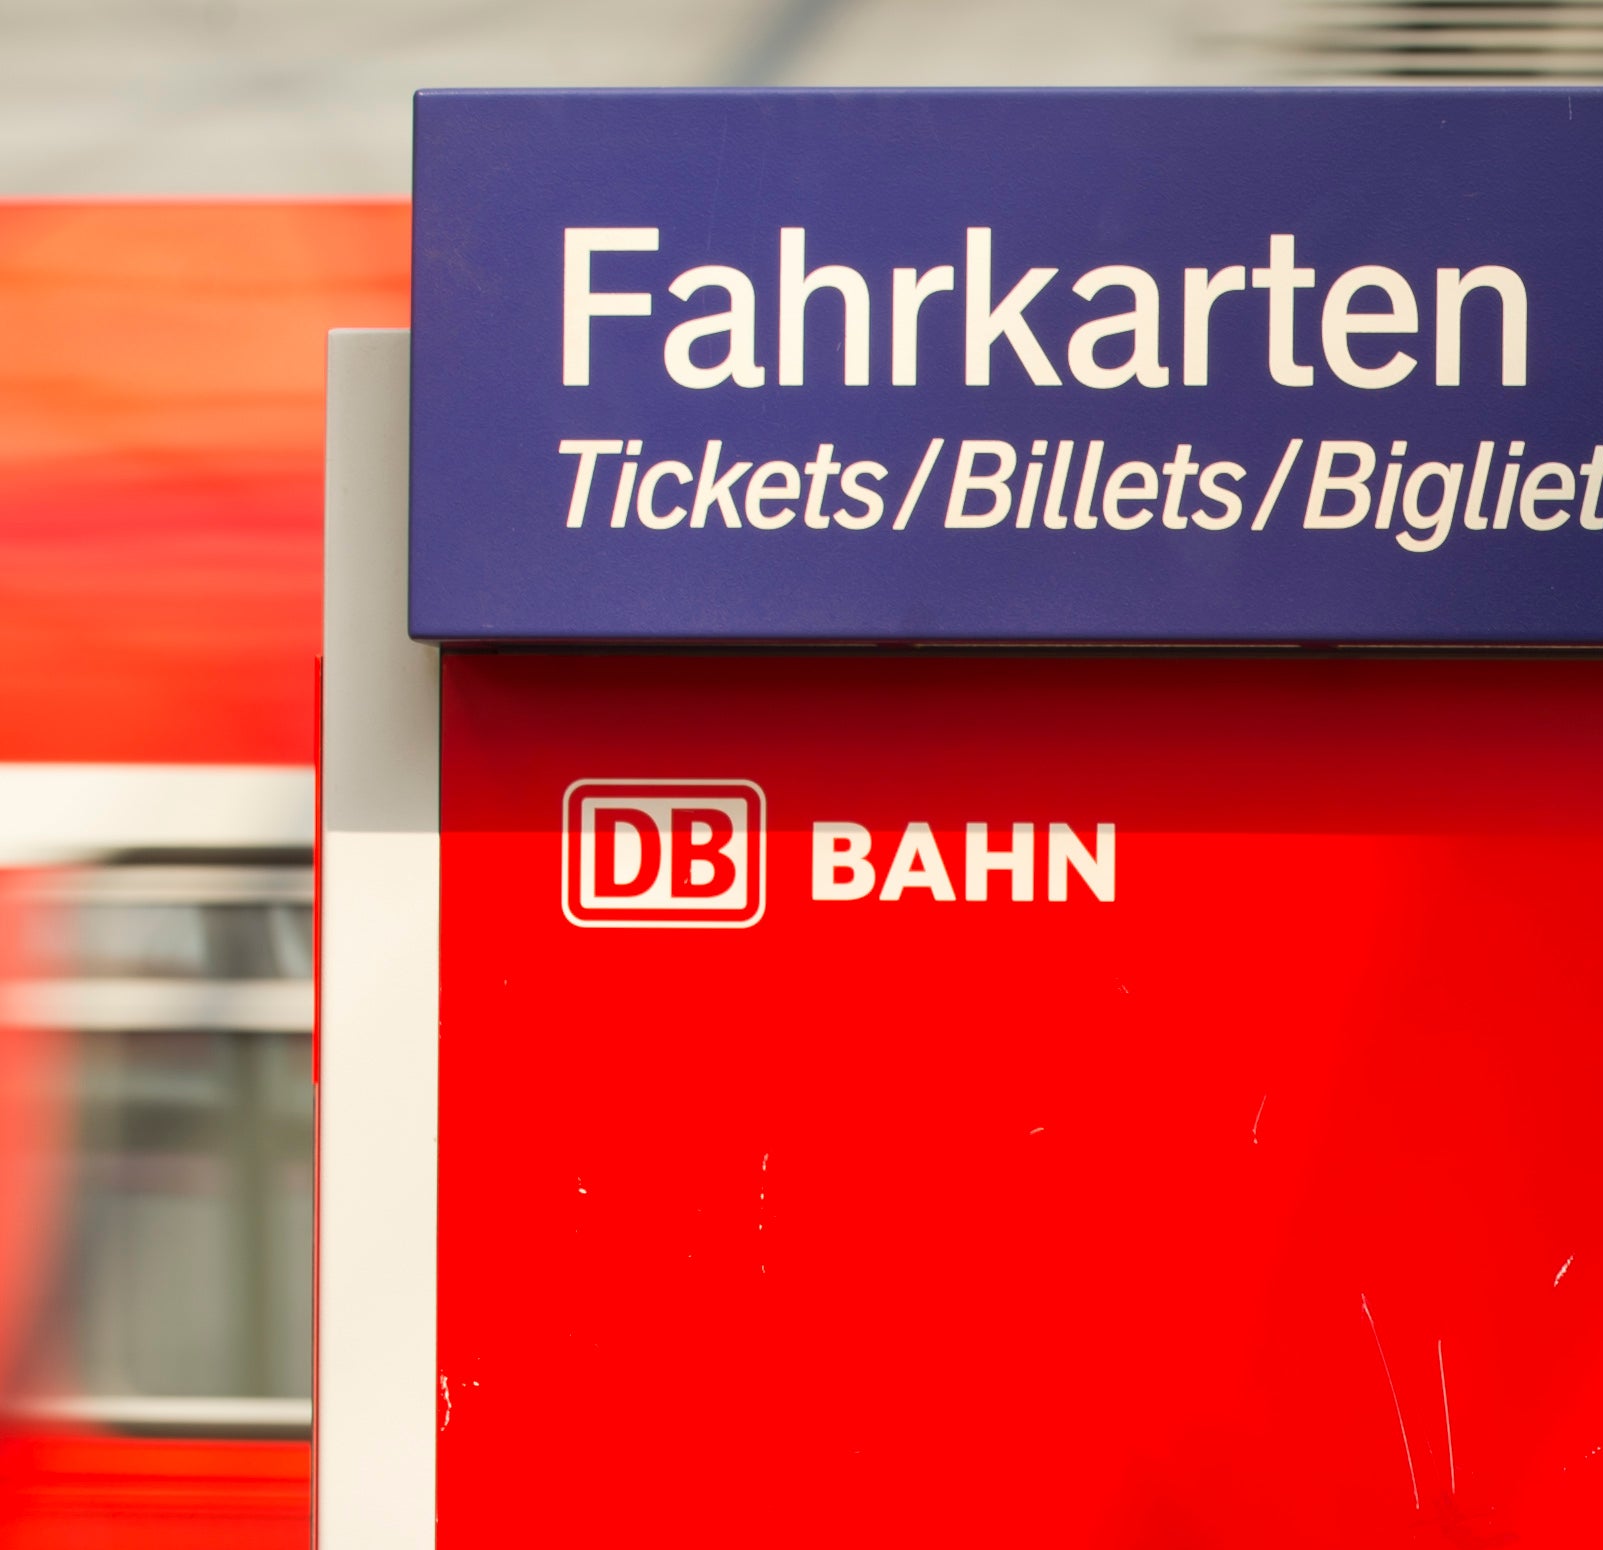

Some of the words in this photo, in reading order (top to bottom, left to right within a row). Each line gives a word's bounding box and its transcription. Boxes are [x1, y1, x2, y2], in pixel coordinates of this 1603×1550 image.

[562, 227, 1527, 390] Fahrkarten
[592, 807, 737, 899] DB
[811, 822, 1116, 902] BAHN
